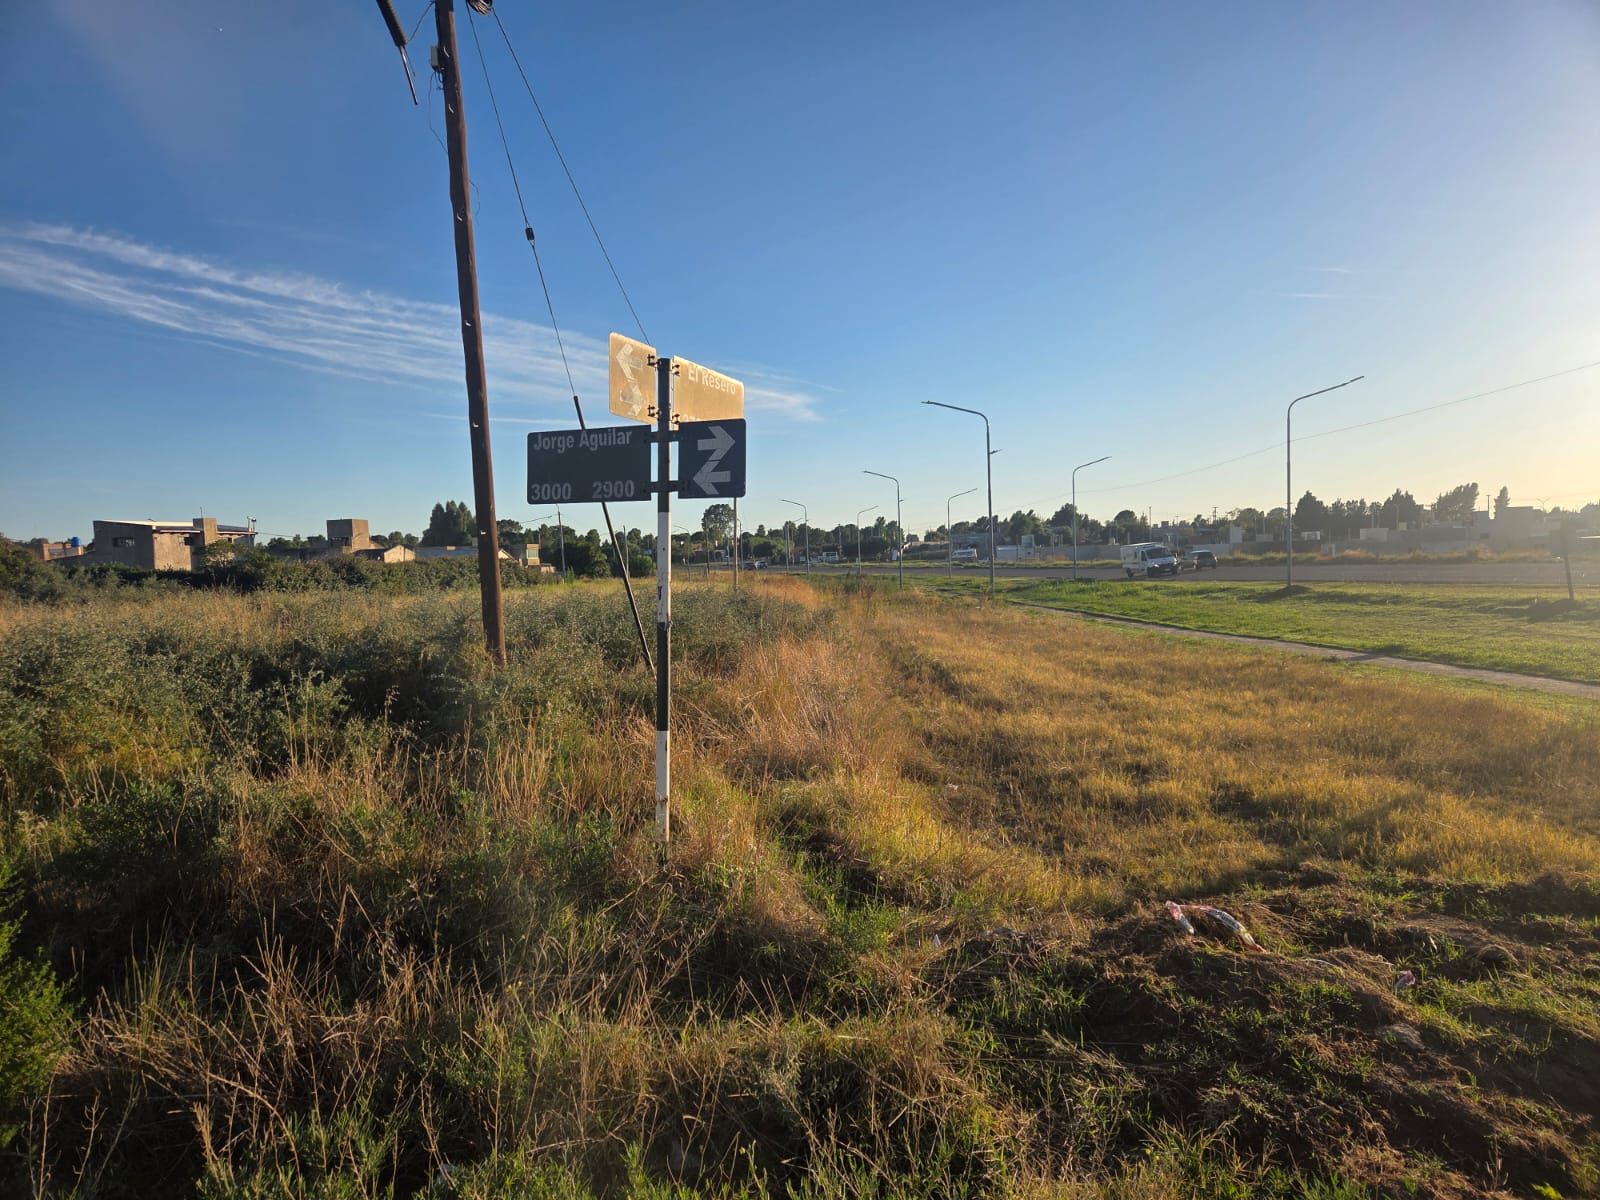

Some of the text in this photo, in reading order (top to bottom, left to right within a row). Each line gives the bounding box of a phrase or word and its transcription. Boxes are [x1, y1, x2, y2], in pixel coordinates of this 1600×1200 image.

[687, 367, 736, 395] El Resero
[533, 429, 632, 454] Jorge Aguilar
[531, 480, 635, 501] 3000 2900
